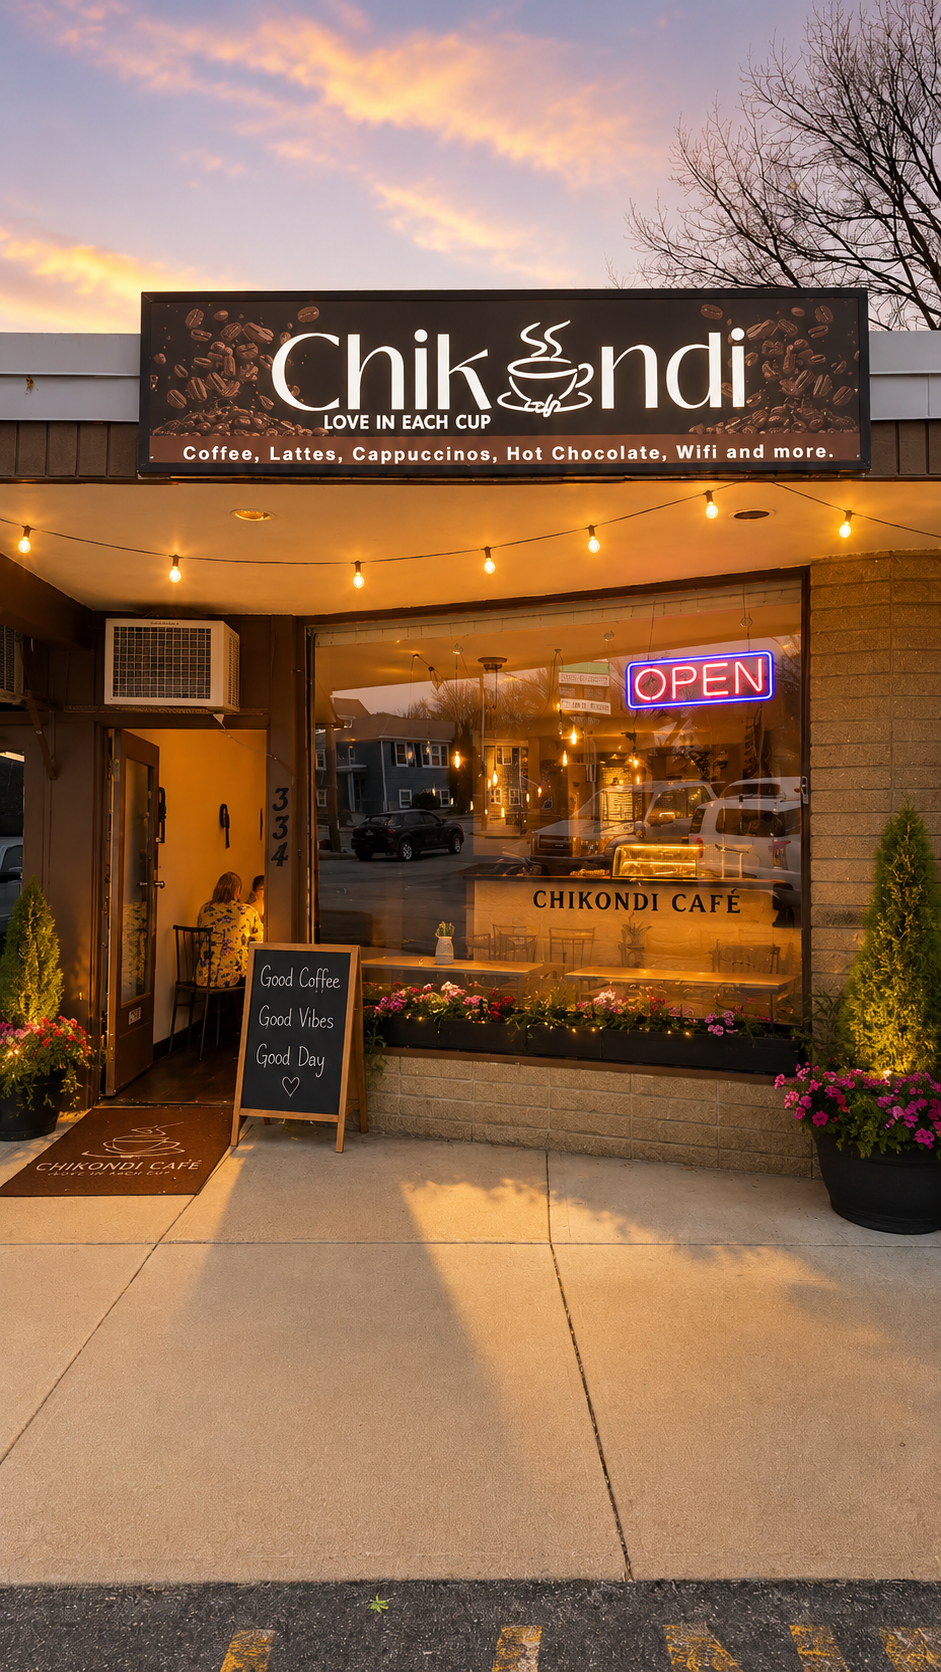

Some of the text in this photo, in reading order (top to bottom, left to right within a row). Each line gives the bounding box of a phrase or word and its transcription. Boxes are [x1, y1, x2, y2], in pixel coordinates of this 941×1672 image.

[324, 414, 491, 430] LOVE IN EACH CUP
[183, 444, 834, 465] Coffee, Lattes, Cappuccinos, Hot Chocolate, Wifi and more.
[634, 658, 764, 701] OPEN
[271, 787, 290, 867] 334
[533, 888, 741, 914] CHIKONDI CAFÉ
[260, 964, 341, 990] Good Coffee
[258, 1004, 334, 1029] Good Vibes
[256, 1043, 325, 1078] Good Day
[36, 1162, 144, 1171] CHIKONDI
